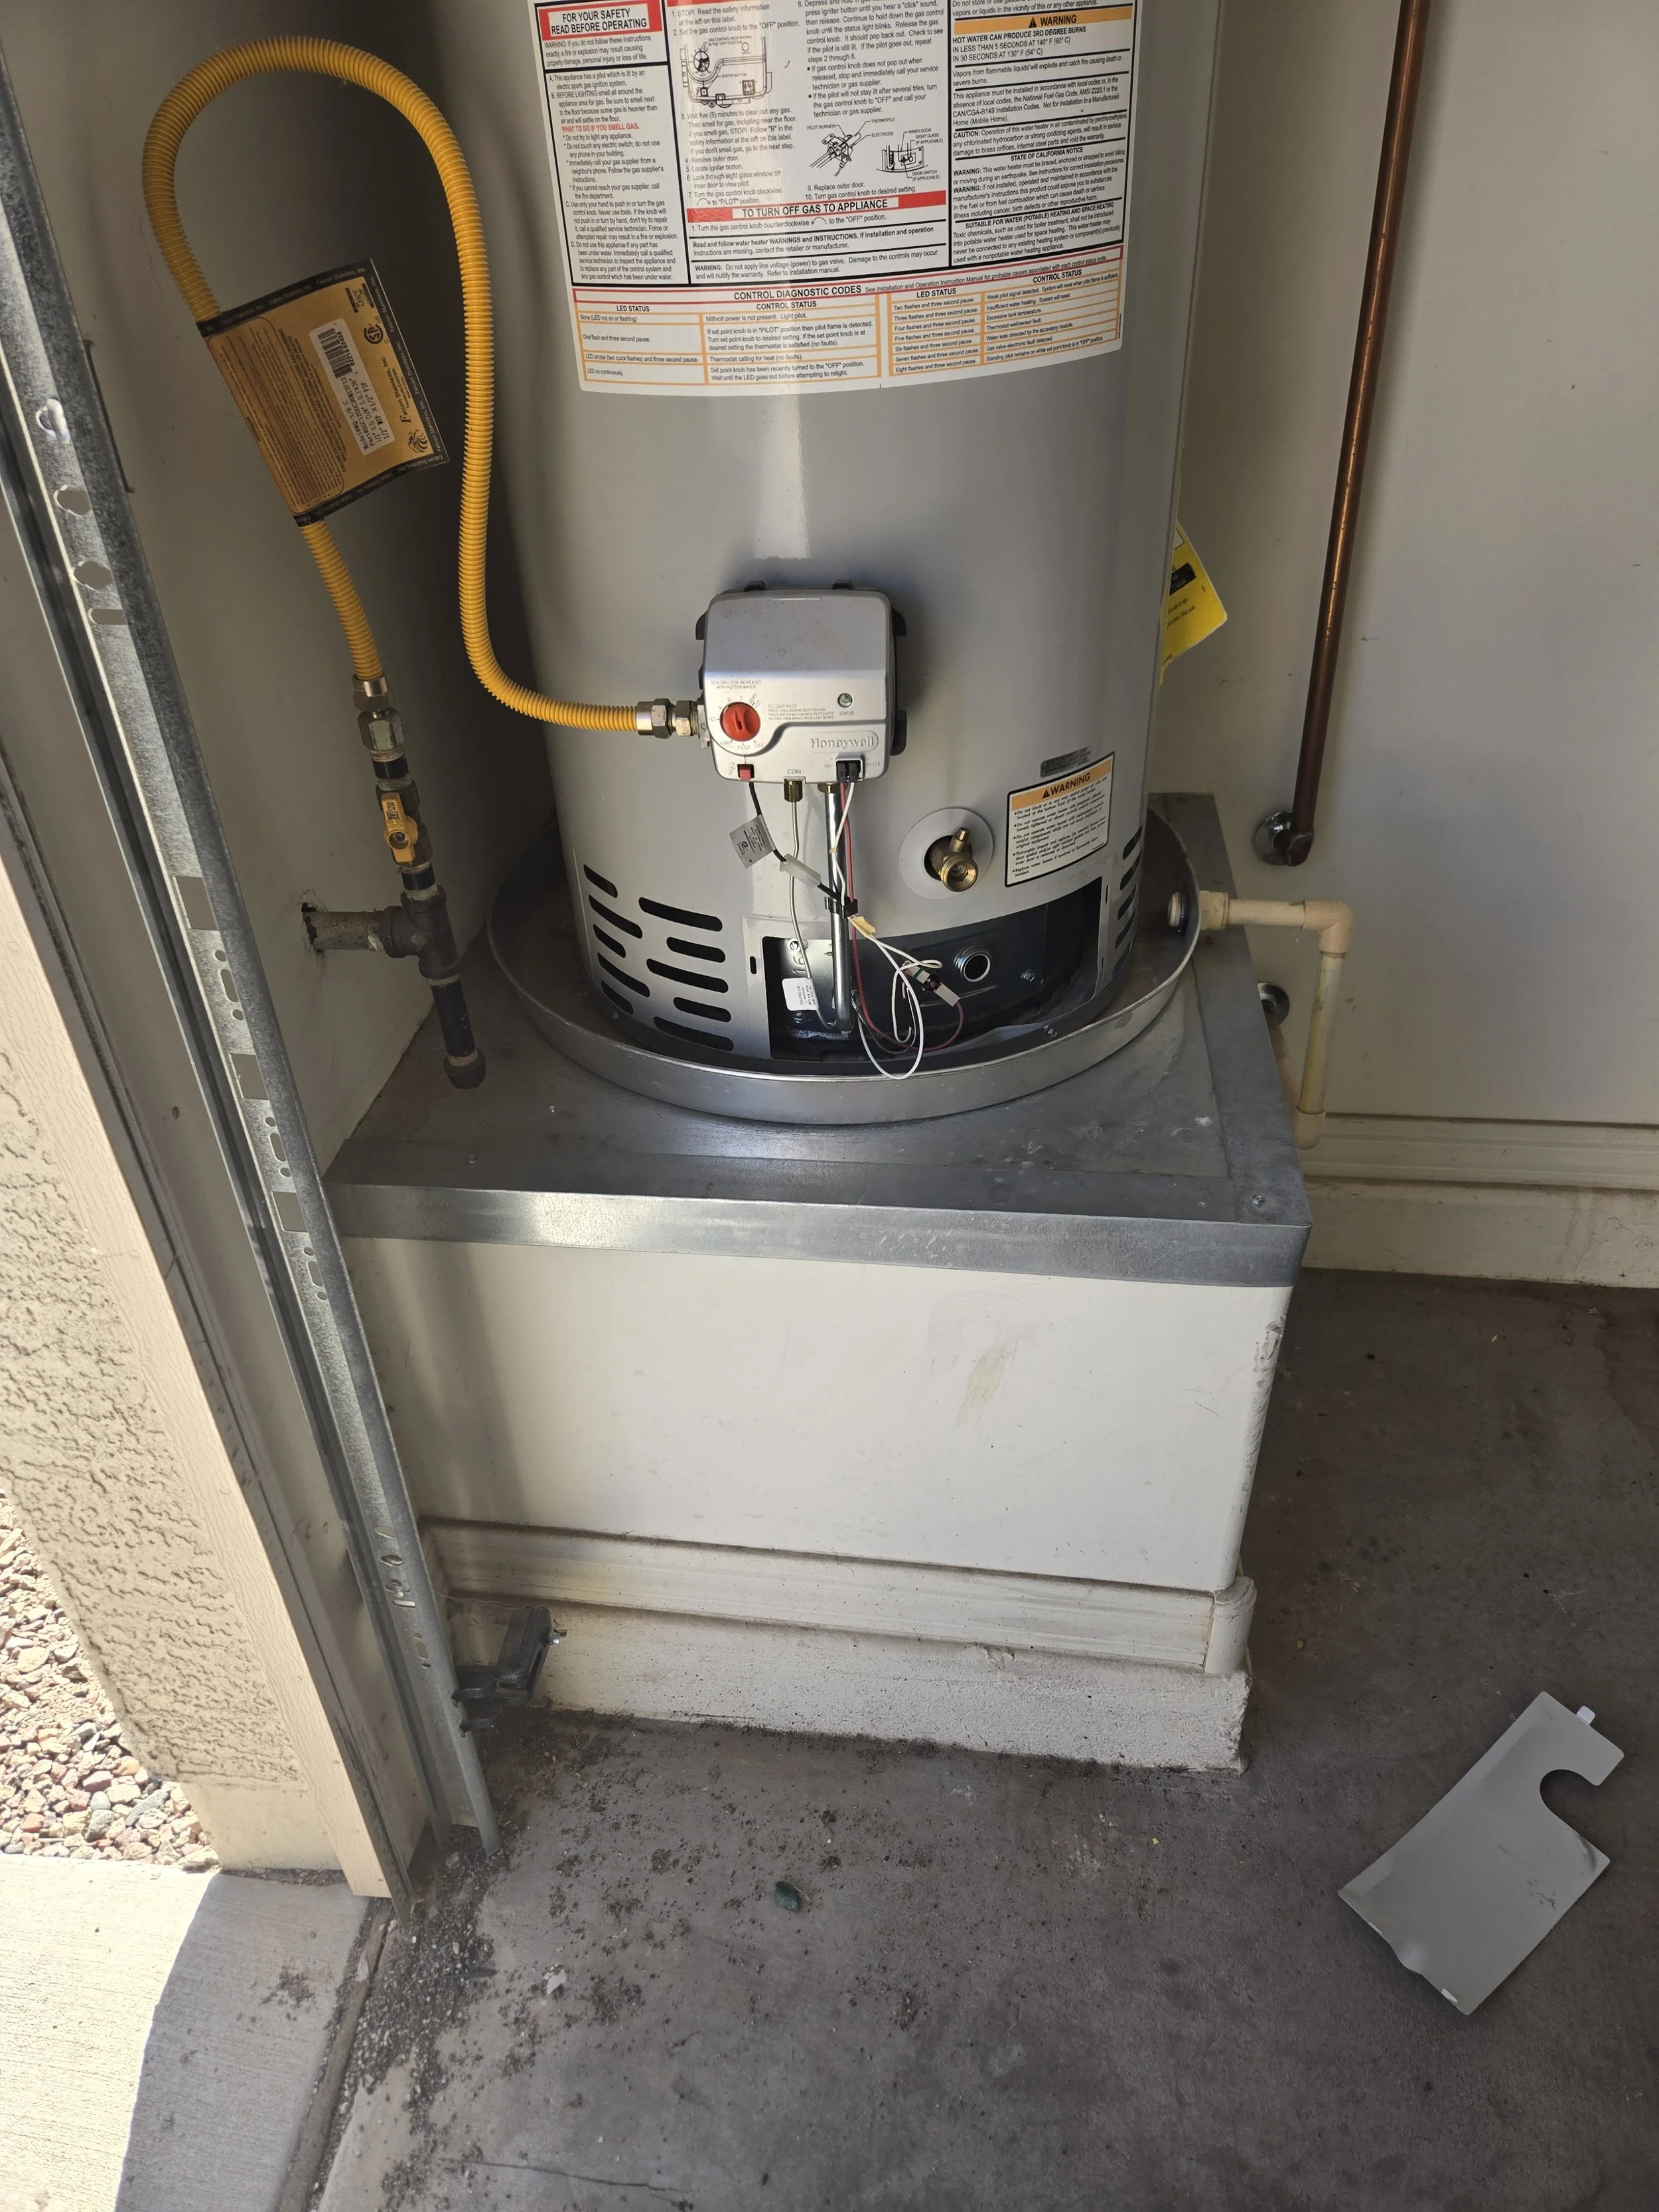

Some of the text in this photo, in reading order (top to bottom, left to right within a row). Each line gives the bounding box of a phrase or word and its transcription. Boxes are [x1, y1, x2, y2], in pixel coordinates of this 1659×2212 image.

[562, 8, 630, 23] FOR YOUR SAFETY
[1041, 15, 1077, 26] WARNING
[551, 18, 647, 35] READ BEFORE OPERATING
[1003, 31, 1031, 40] PRODUCE
[1045, 27, 1067, 36] DEGREE
[999, 40, 1027, 49] SECONDS
[828, 53, 849, 62] through
[1035, 149, 1065, 158] CALIFORNIA
[742, 198, 888, 218] TO TURN OFF GAS TO APPLIANCE
[965, 220, 991, 228] SUITABLE
[1023, 212, 1049, 222] (POTABLE)
[814, 232, 858, 242] INSTRUCTIONS.
[908, 226, 934, 235] operation
[1033, 269, 1082, 283] CONTROL STATUS
[734, 285, 861, 300] CONTROL DIAGNOSTIC CODES
[931, 287, 956, 297] STATUS
[790, 300, 816, 309] STATUS
[387, 368, 399, 398] Stainless,
[410, 377, 419, 394] Falcon
[398, 399, 411, 423] Falcon
[811, 737, 874, 749] Honeywell
[1050, 773, 1091, 795] WARNING
